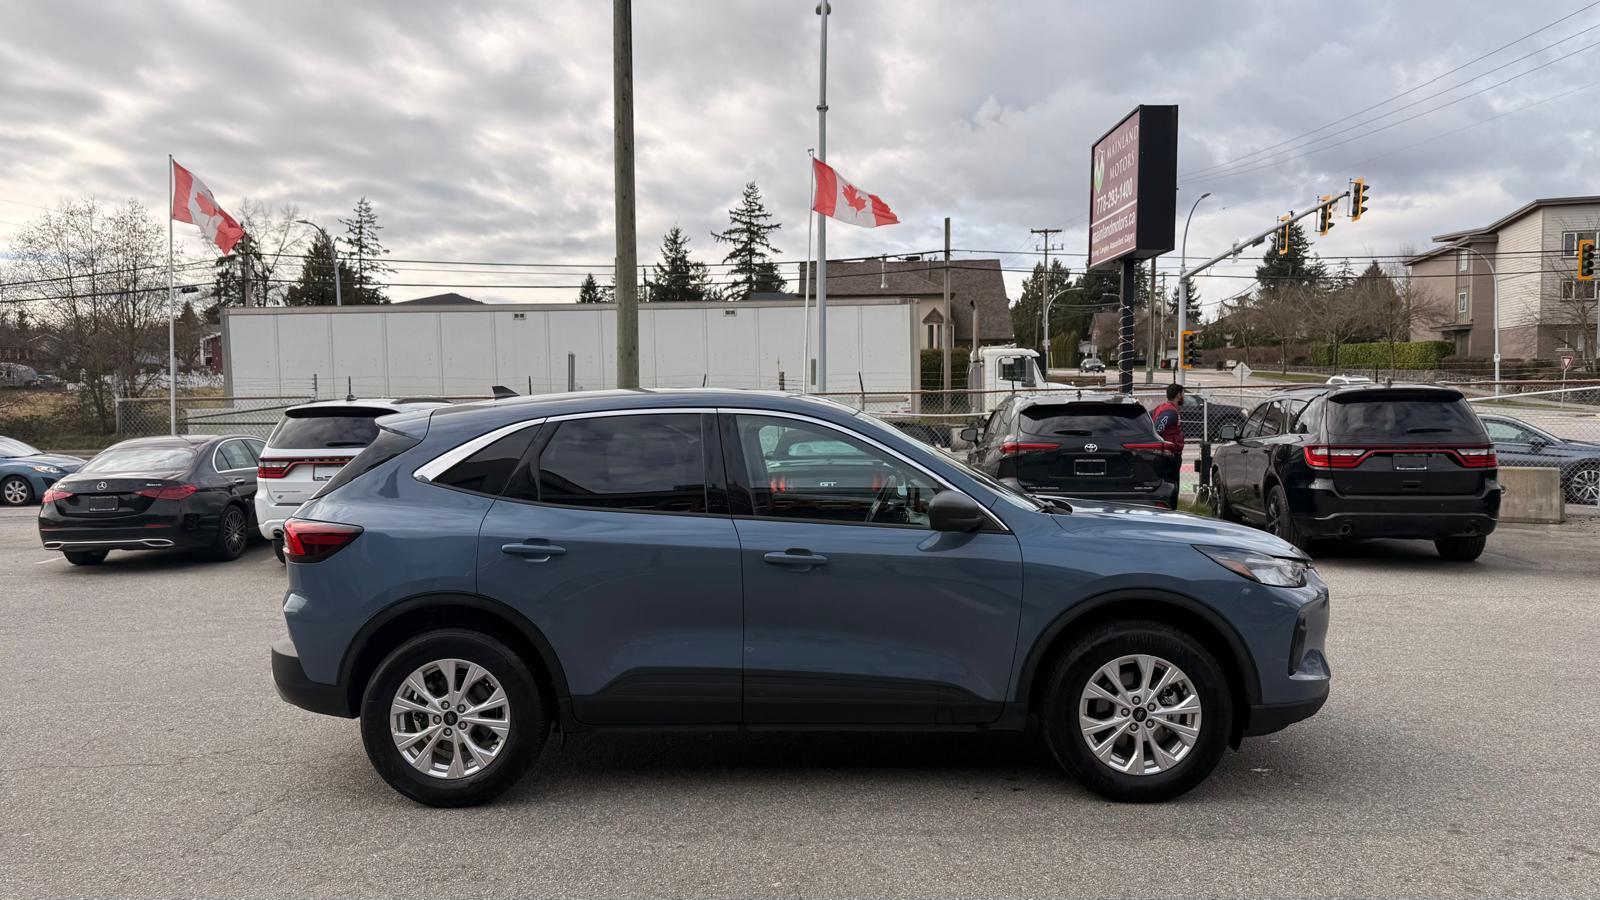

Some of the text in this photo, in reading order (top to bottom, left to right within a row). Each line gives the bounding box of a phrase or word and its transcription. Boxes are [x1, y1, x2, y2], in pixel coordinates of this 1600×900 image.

[1106, 125, 1139, 160] MAINLAND
[1109, 150, 1135, 181] MOTORS
[1097, 177, 1133, 214] 778-293-1400
